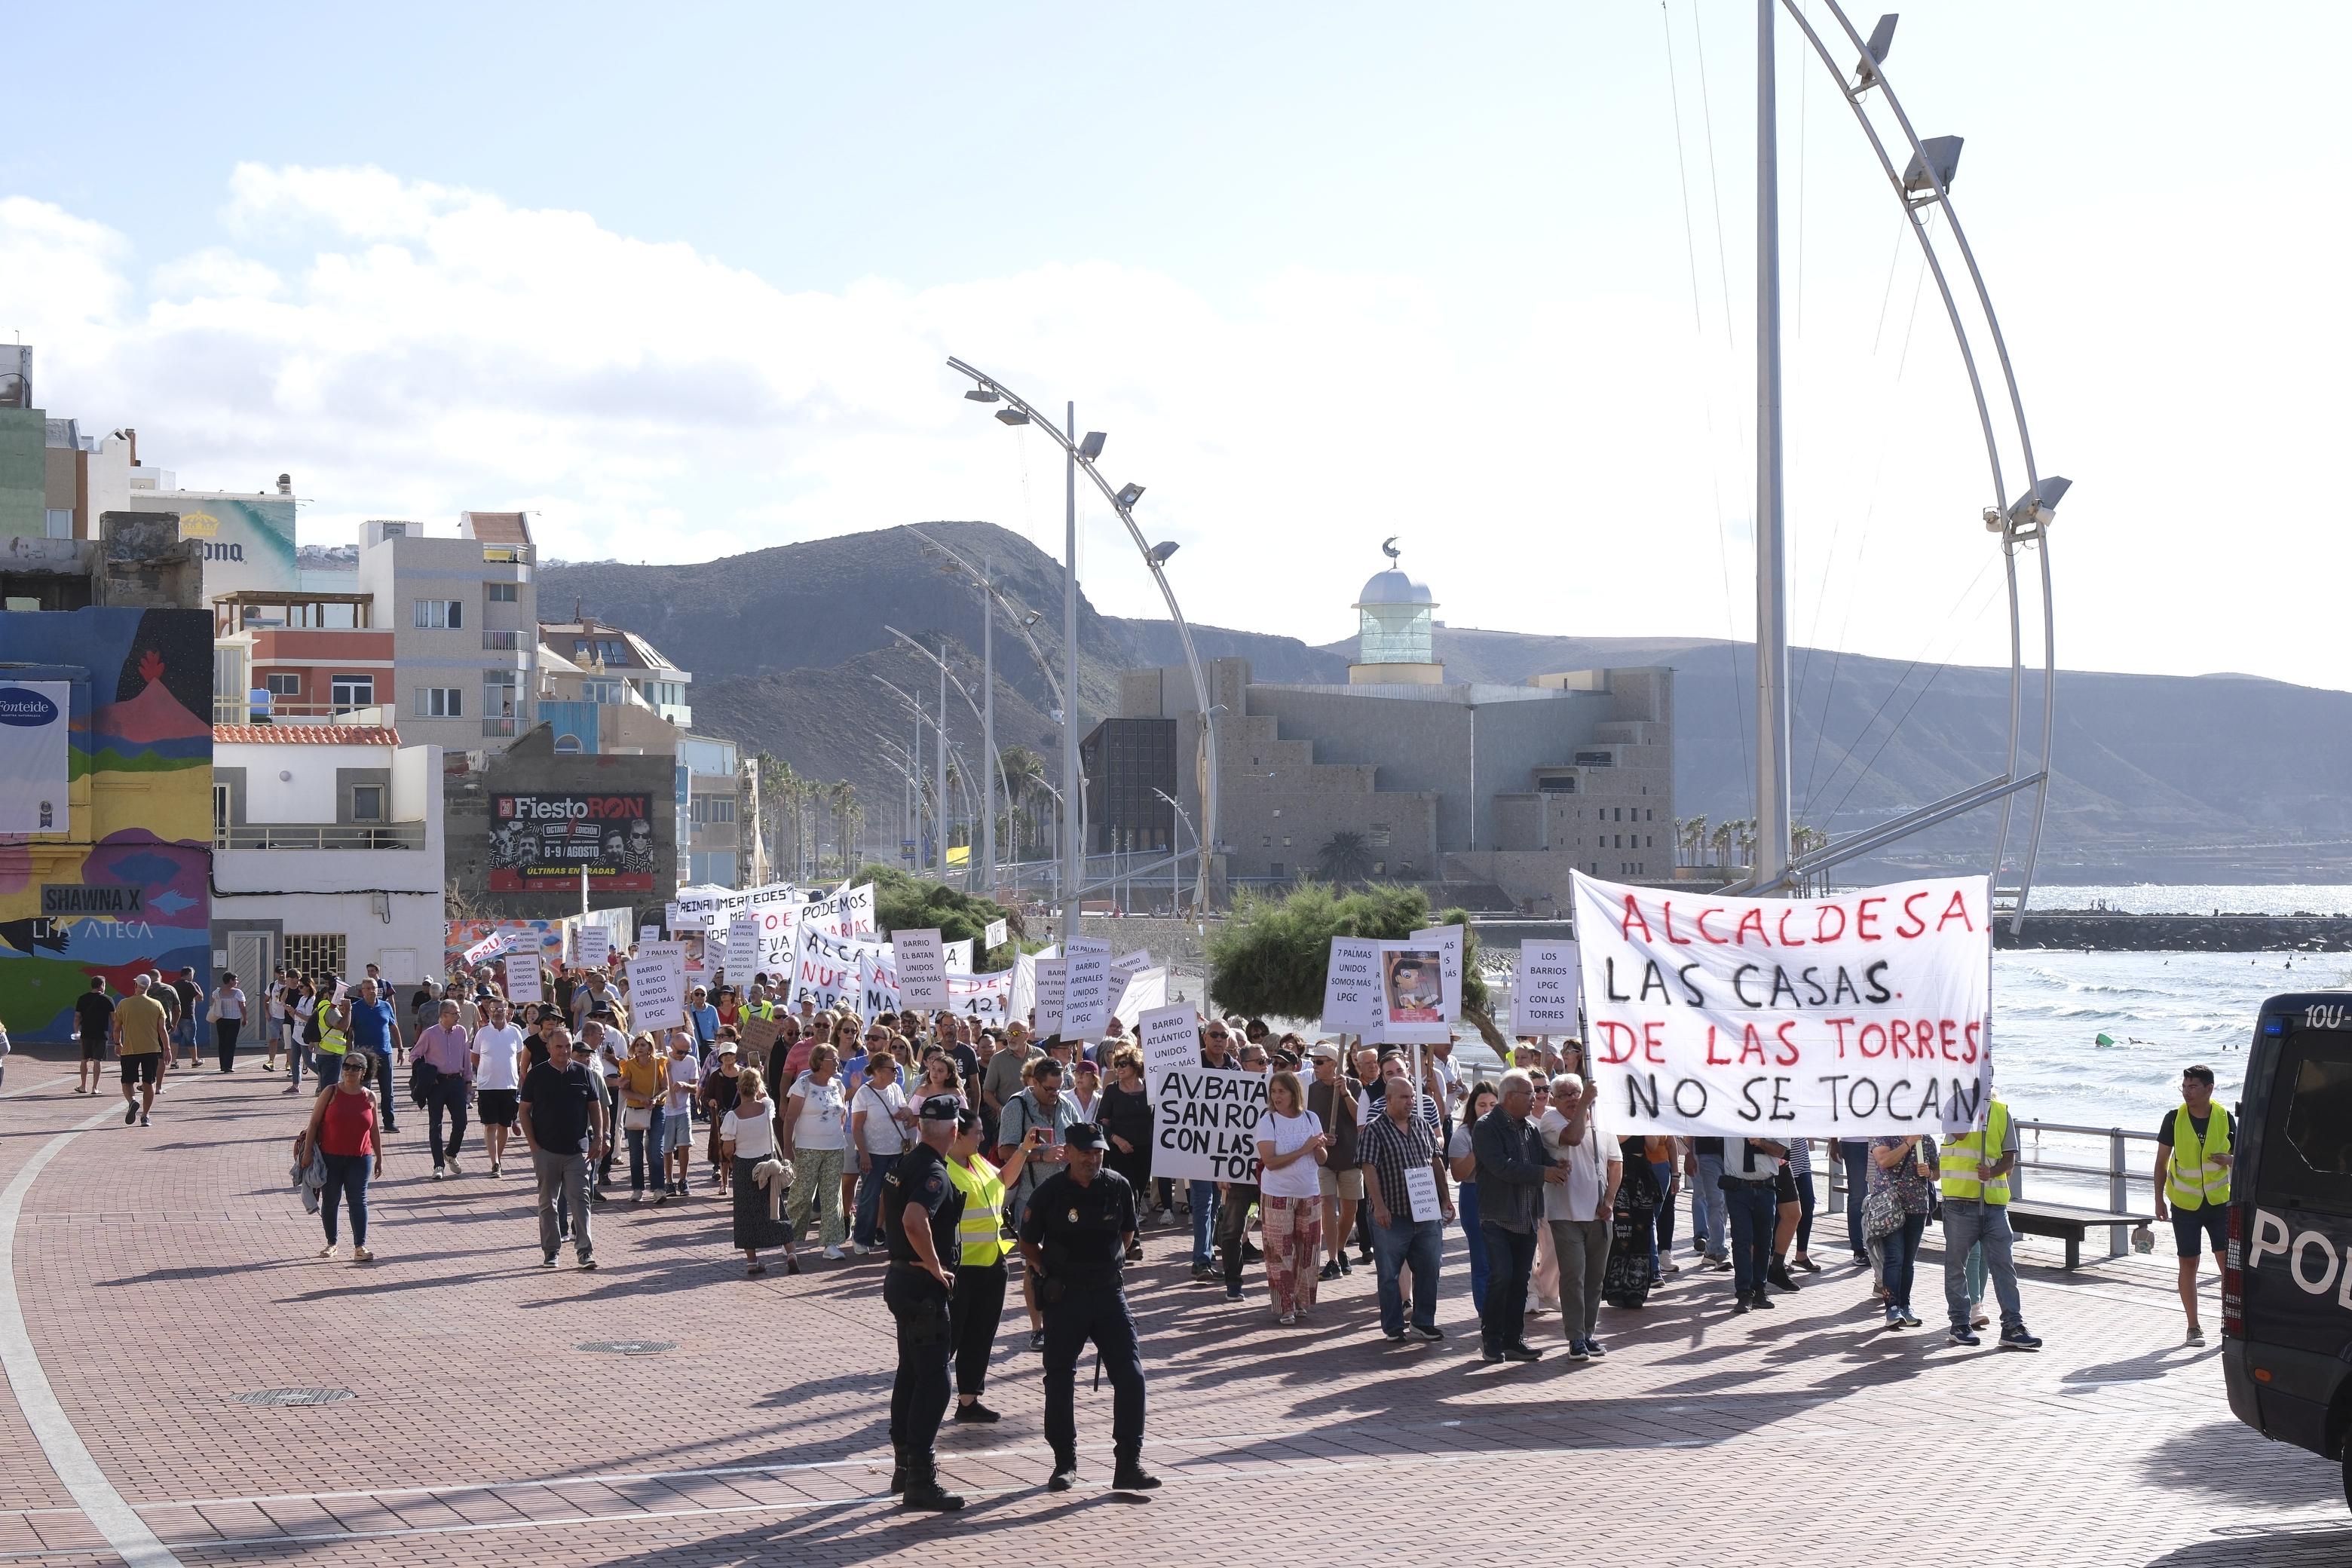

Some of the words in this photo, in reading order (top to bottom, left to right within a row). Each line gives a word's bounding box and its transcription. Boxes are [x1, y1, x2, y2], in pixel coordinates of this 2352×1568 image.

[204, 542, 244, 562] ona
[575, 825, 598, 835] EDICIÓN
[544, 846, 562, 858] 8-9
[567, 846, 599, 858] AGOSTO
[527, 866, 566, 875] ÚLTIMAS
[568, 867, 616, 875] ENRADAS
[46, 889, 124, 911] SHAWNA
[128, 889, 141, 911] X
[84, 920, 154, 939] ATECA
[758, 935, 790, 952] EVA
[902, 939, 930, 948] BARRIO
[769, 951, 792, 964] CO
[1337, 948, 1342, 957] 7
[1343, 949, 1372, 959] PALMAS
[1542, 952, 1557, 960] LOS
[1075, 961, 1100, 971] BARRIO
[1119, 957, 1141, 969] BARRIO
[1339, 963, 1367, 973] UNIDOS
[636, 964, 663, 975] BARRIO
[1530, 966, 1567, 975] BARRIOS
[646, 975, 666, 985] RISCO
[926, 974, 942, 982] MÁS
[1070, 974, 1103, 985] ARENALES
[1331, 977, 1355, 986] SOMOS
[1356, 978, 1371, 987] MÁS
[1604, 956, 1704, 1008] LAS
[639, 986, 667, 997] UNIDOS
[911, 988, 932, 996] LPGC
[1073, 988, 1098, 997] UNIDOS
[635, 998, 659, 1008] SOMOS
[660, 996, 675, 1004] MÁS
[1337, 993, 1358, 1002] LPGC
[1530, 995, 1548, 1003] CON
[1550, 996, 1565, 1004] LAS
[1066, 1000, 1088, 1010] SOMOS
[1089, 999, 1104, 1007] MÁS
[645, 1009, 666, 1019] LPGC
[1072, 1013, 1092, 1024] LPGC
[1529, 1010, 1564, 1019] TORRES
[1152, 1017, 1184, 1030] BARRIO
[1147, 1030, 1192, 1046] ATLÁNTICO
[1596, 1020, 1665, 1064] DE
[1705, 1020, 1802, 1067] LAS
[1154, 1046, 1187, 1058] UNIDOS
[1178, 1058, 1196, 1067] MÁS
[1625, 1073, 1708, 1119] NO
[1737, 1076, 1796, 1122] SE
[1162, 1100, 1219, 1128] SAN
[1225, 1103, 1269, 1129] RO
[1160, 1128, 1210, 1155] CON
[1217, 1132, 1254, 1156] LAS
[1209, 1155, 1260, 1181] TOR
[1419, 1206, 1432, 1214] LPGC
[2249, 1208, 2352, 1311] POL
